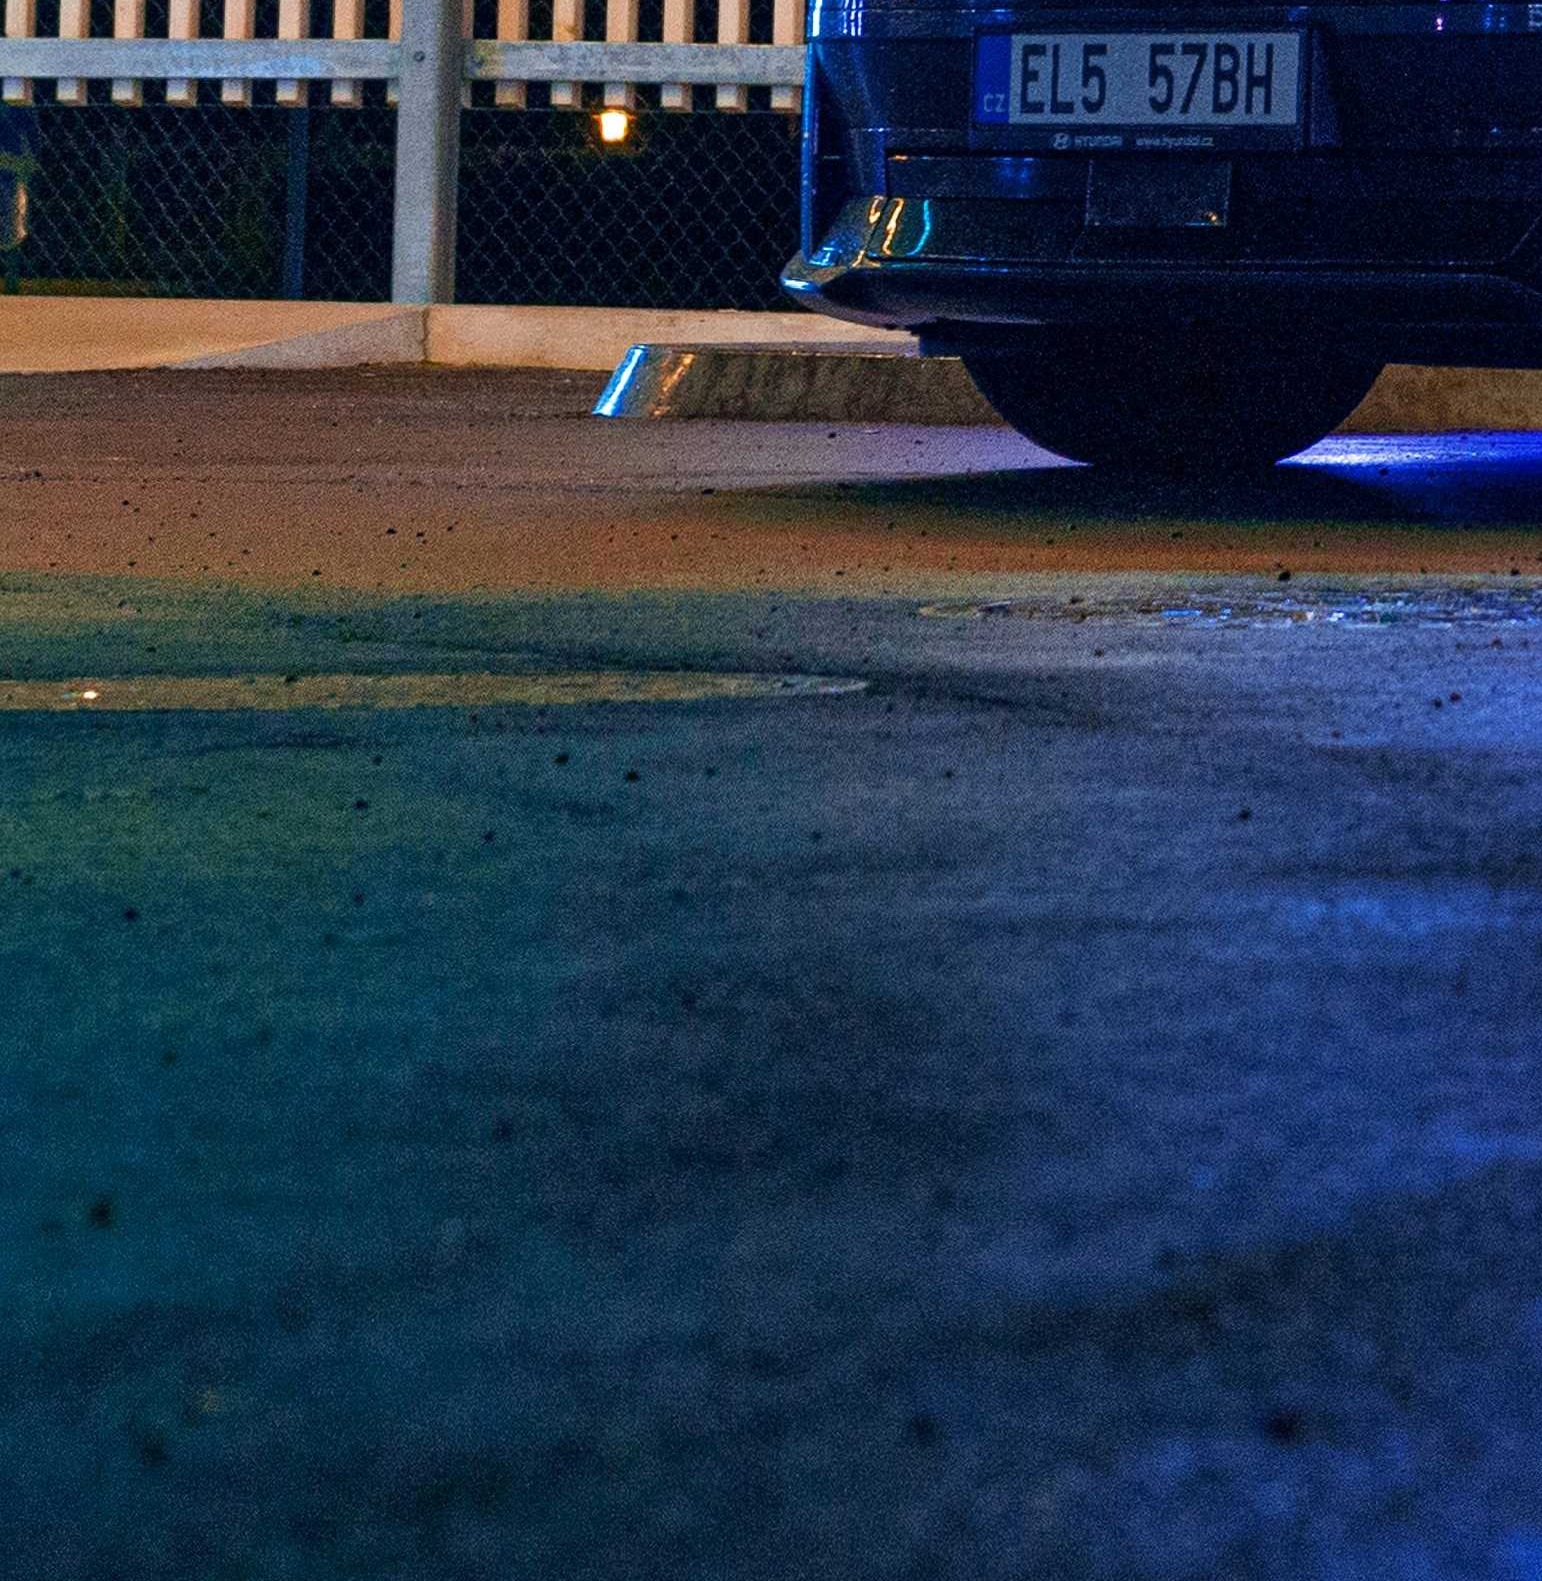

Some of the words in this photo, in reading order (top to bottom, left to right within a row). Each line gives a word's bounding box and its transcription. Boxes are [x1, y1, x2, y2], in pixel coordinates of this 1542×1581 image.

[1020, 42, 1108, 115] EL5
[1148, 42, 1274, 115] 57BH
[983, 93, 1005, 113] CZ
